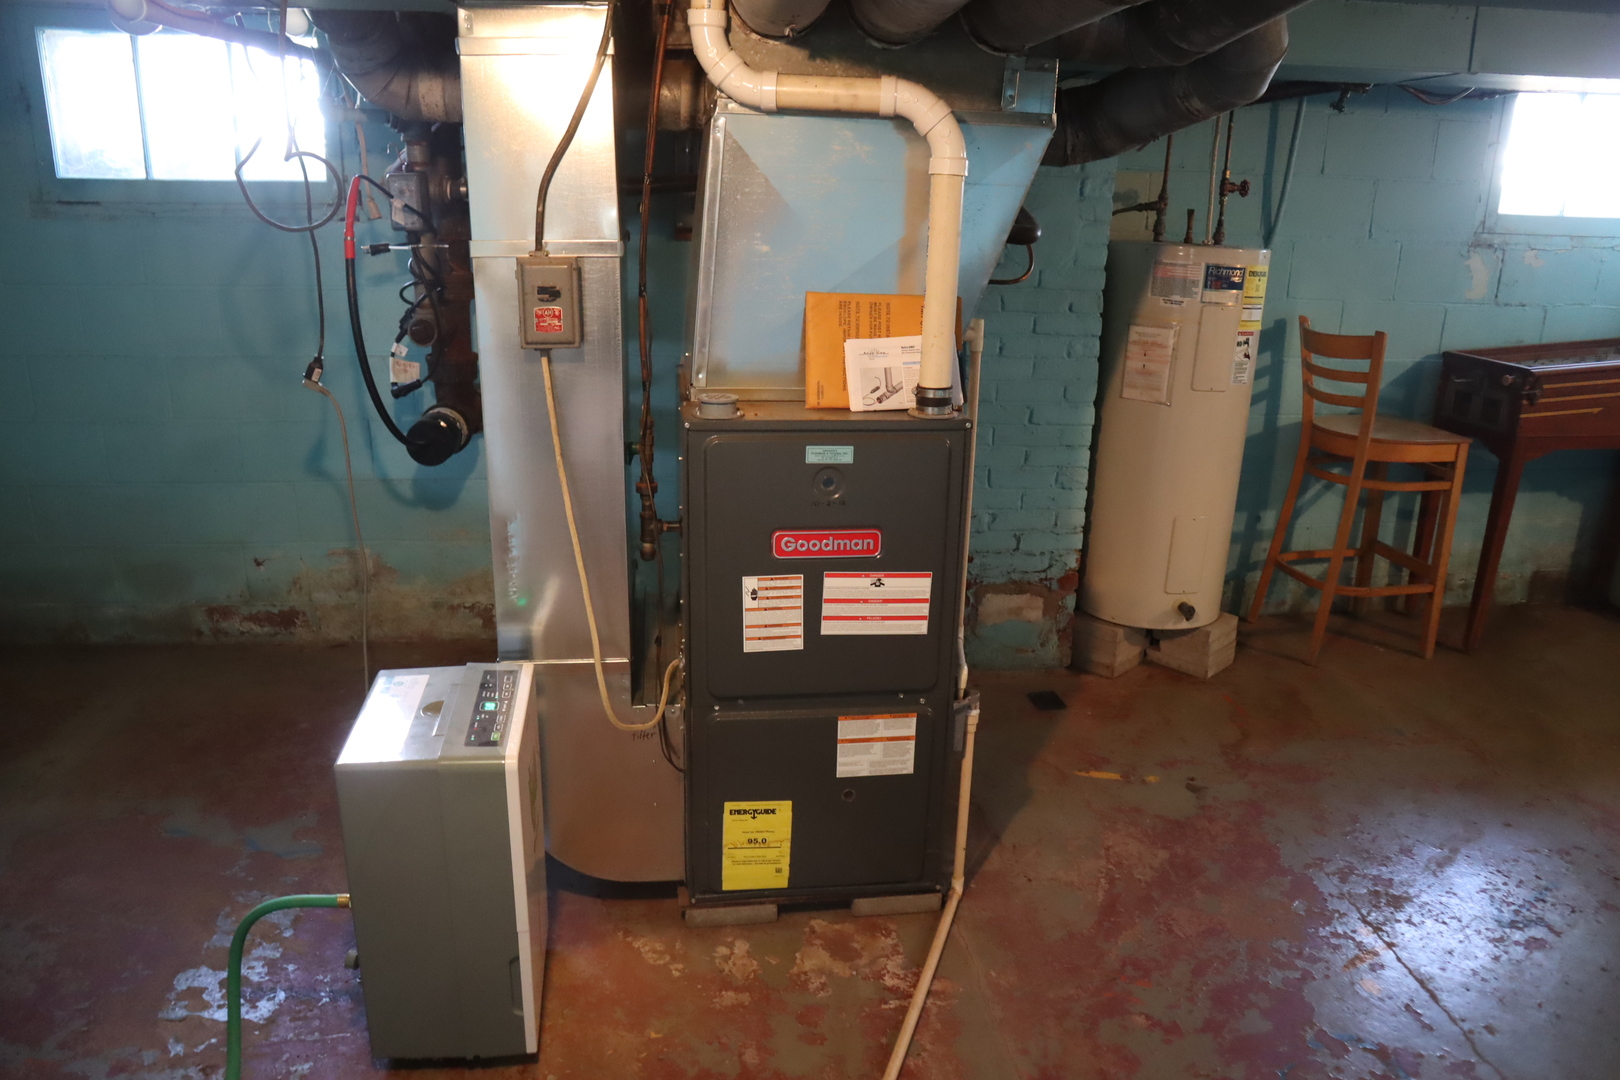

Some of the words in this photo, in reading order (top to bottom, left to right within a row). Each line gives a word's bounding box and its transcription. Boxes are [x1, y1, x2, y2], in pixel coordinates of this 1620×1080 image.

[1208, 266, 1244, 276] Richmond
[780, 536, 874, 552] Goodman
[729, 808, 777, 817] ENERGYGUIDE
[747, 837, 767, 845] 95.0
